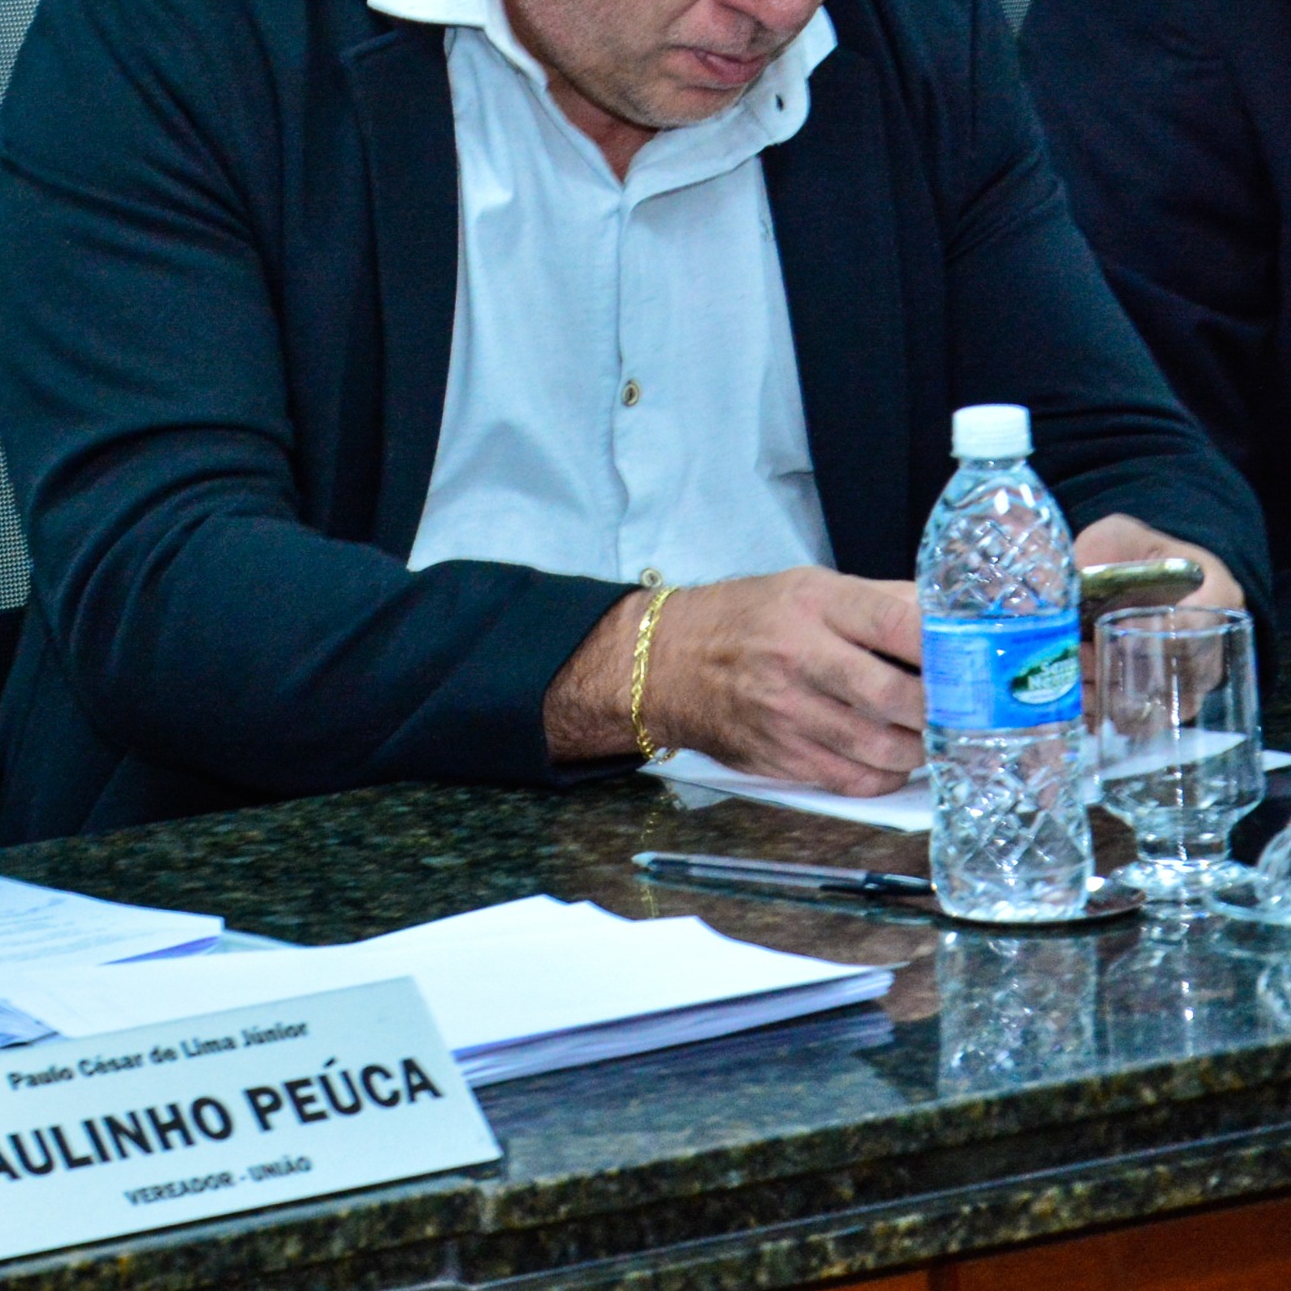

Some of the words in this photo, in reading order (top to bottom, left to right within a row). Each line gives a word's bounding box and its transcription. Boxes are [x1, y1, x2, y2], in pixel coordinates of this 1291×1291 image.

[8, 1068, 74, 1091] Paulo
[78, 1049, 145, 1079] César
[150, 1044, 177, 1065] de
[182, 1030, 238, 1057] Lima
[242, 1021, 309, 1047] Júnior
[246, 1058, 444, 1131] PEÚCA
[124, 1172, 236, 1206] VEREADOR
[248, 1155, 314, 1182] UNIÃO
